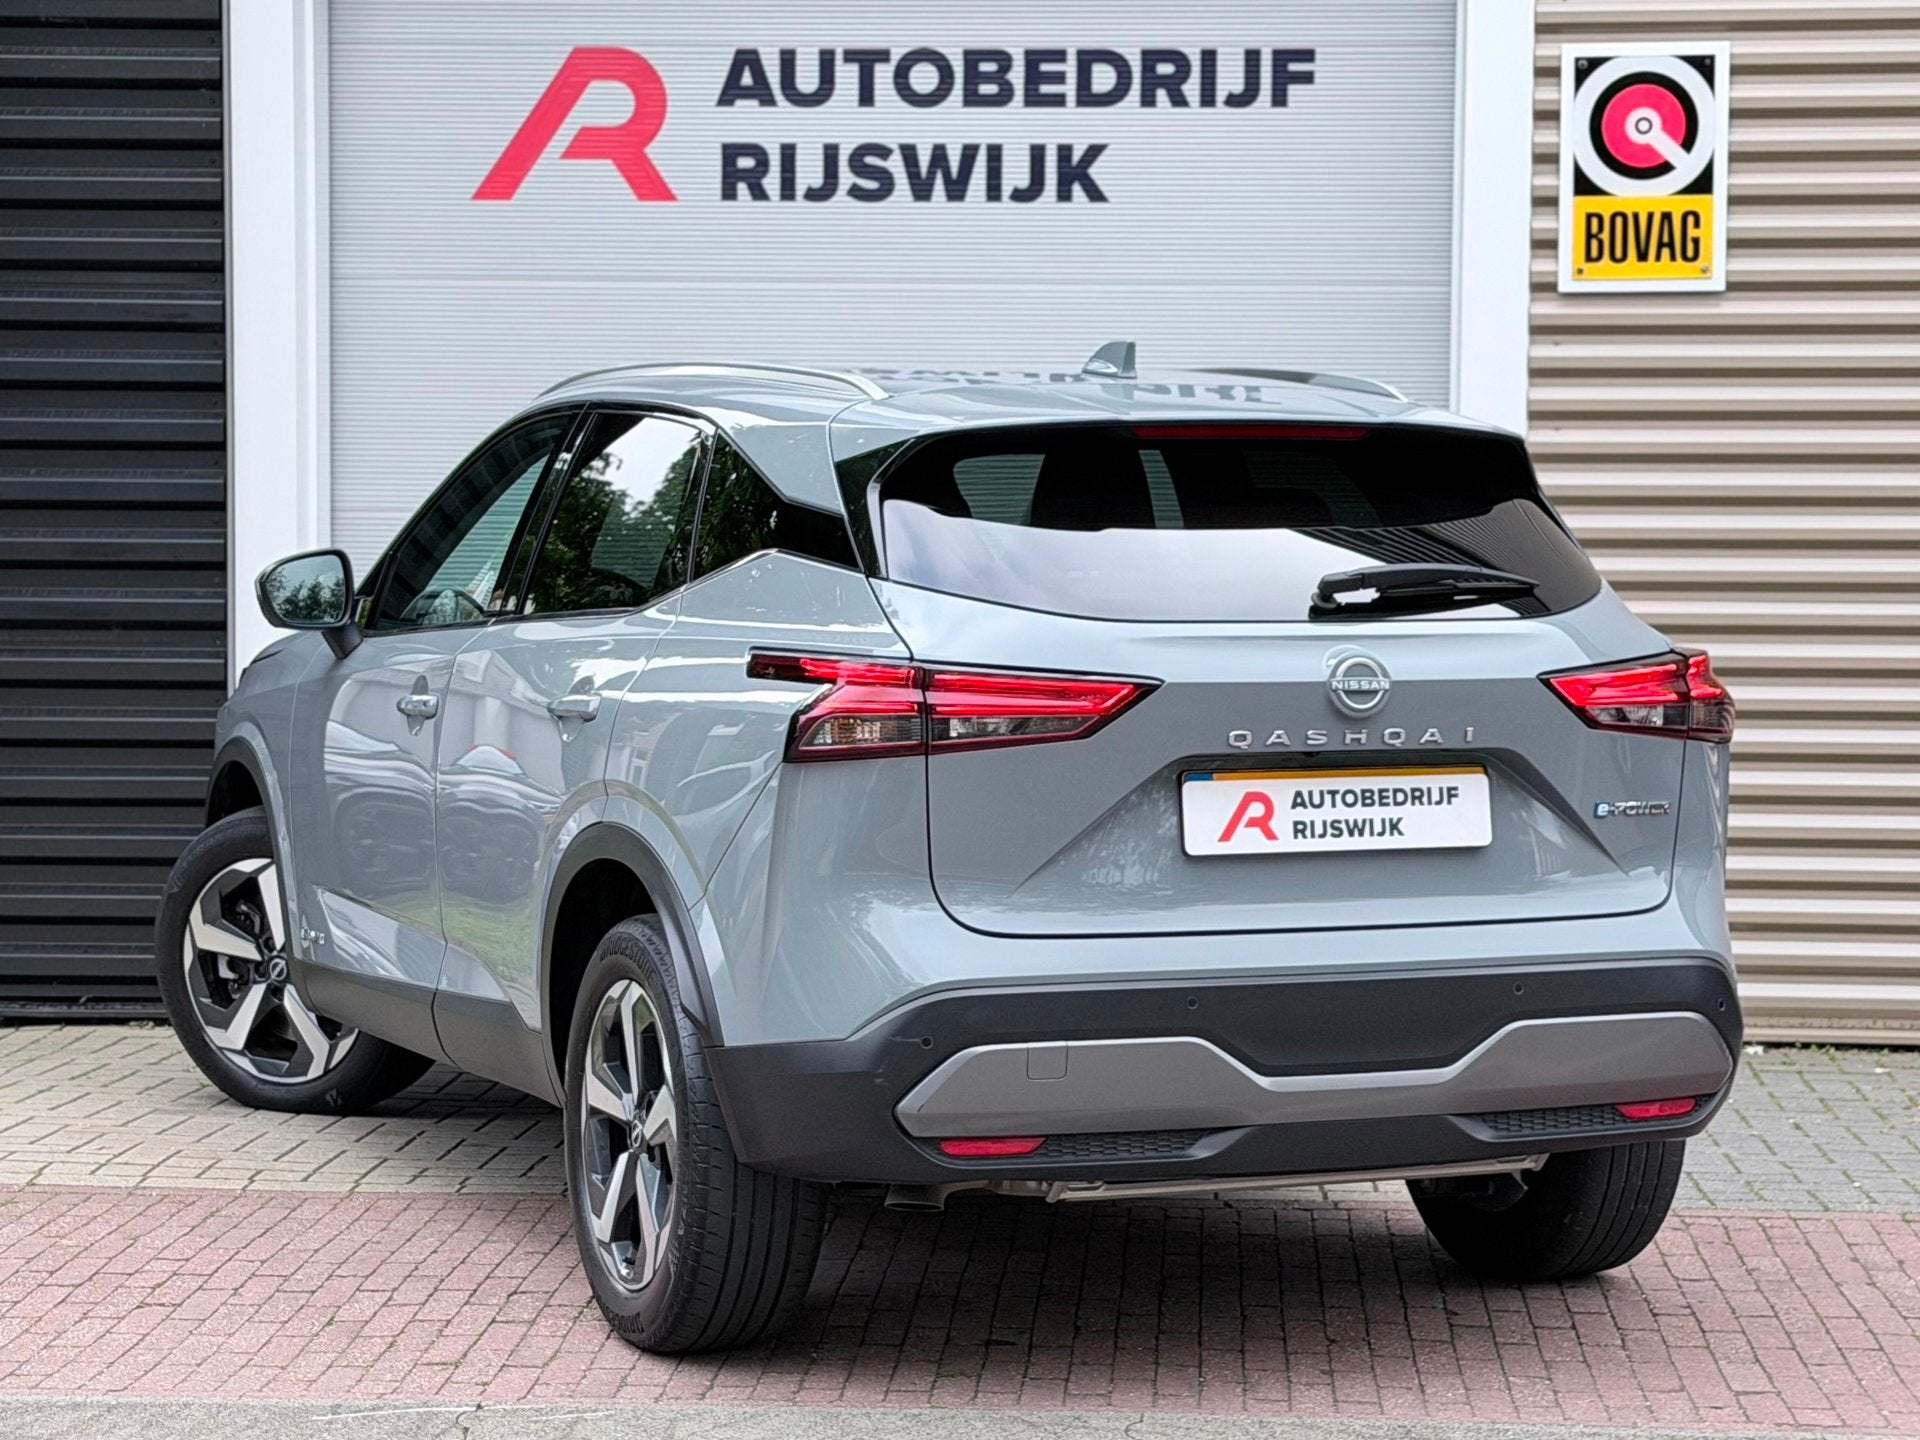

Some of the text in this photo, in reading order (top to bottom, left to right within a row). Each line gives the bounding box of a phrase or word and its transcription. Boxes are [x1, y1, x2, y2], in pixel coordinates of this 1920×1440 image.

[716, 47, 1316, 109] AUTOBEDRIJF
[721, 142, 1109, 203] RIJSWIJK
[1584, 210, 1701, 264] BOVAG
[1331, 679, 1390, 690] NISSAN
[1228, 726, 1475, 749] QASHQAI
[1290, 785, 1460, 811] AUTOBEDRIJF
[1293, 816, 1405, 841] RIJSWIJK
